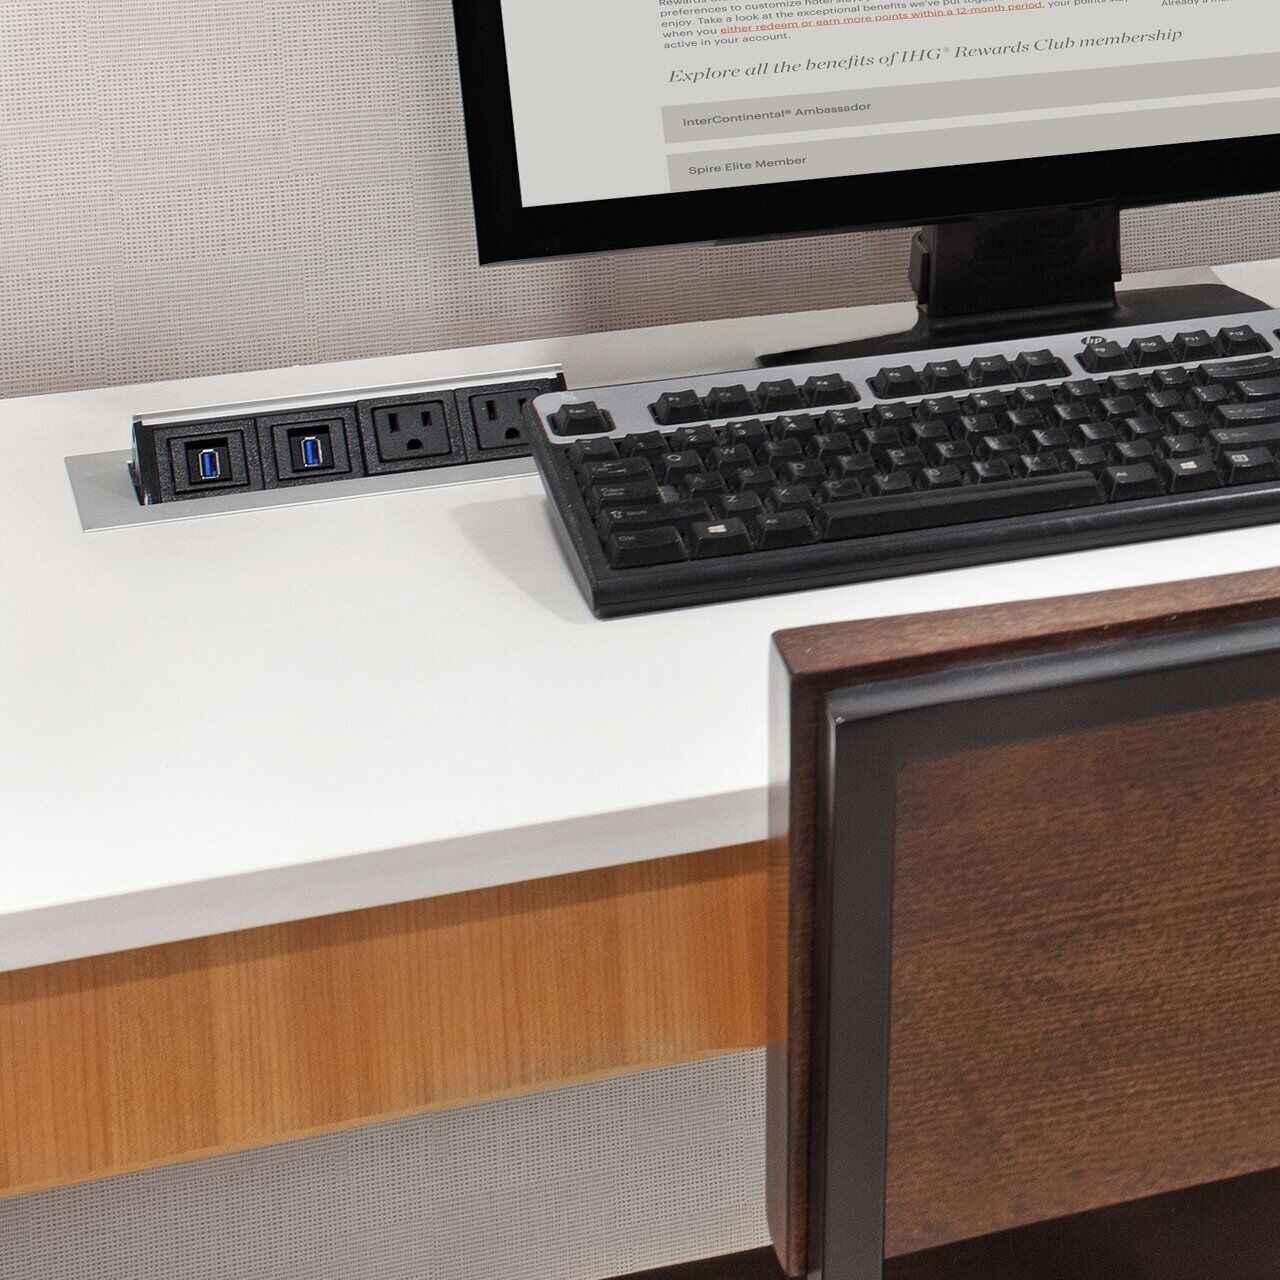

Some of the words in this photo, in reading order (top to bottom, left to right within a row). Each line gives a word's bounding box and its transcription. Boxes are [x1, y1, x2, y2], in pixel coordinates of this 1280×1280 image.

[662, 30, 694, 38] when
[719, 25, 753, 34] either
[755, 21, 799, 31] redeem
[815, 18, 841, 26] earn
[843, 16, 873, 24] more
[874, 12, 909, 21] points
[910, 9, 945, 18] within
[955, 4, 1006, 15] 12-month
[1007, 0, 1045, 11] period,
[663, 40, 698, 49] active
[700, 38, 712, 46] in
[713, 37, 739, 47] your
[742, 32, 791, 43] account.
[668, 67, 741, 84] Explore
[744, 62, 769, 76] all
[773, 60, 802, 74] the
[805, 54, 875, 71] benefits
[878, 51, 900, 67] of
[954, 40, 1030, 59] Rewards
[1033, 36, 1075, 52] Club
[1079, 28, 1183, 48] membership
[795, 102, 872, 117] Ambassador
[688, 164, 722, 176] Spire
[725, 161, 752, 171] Elite
[754, 157, 808, 169] Member
